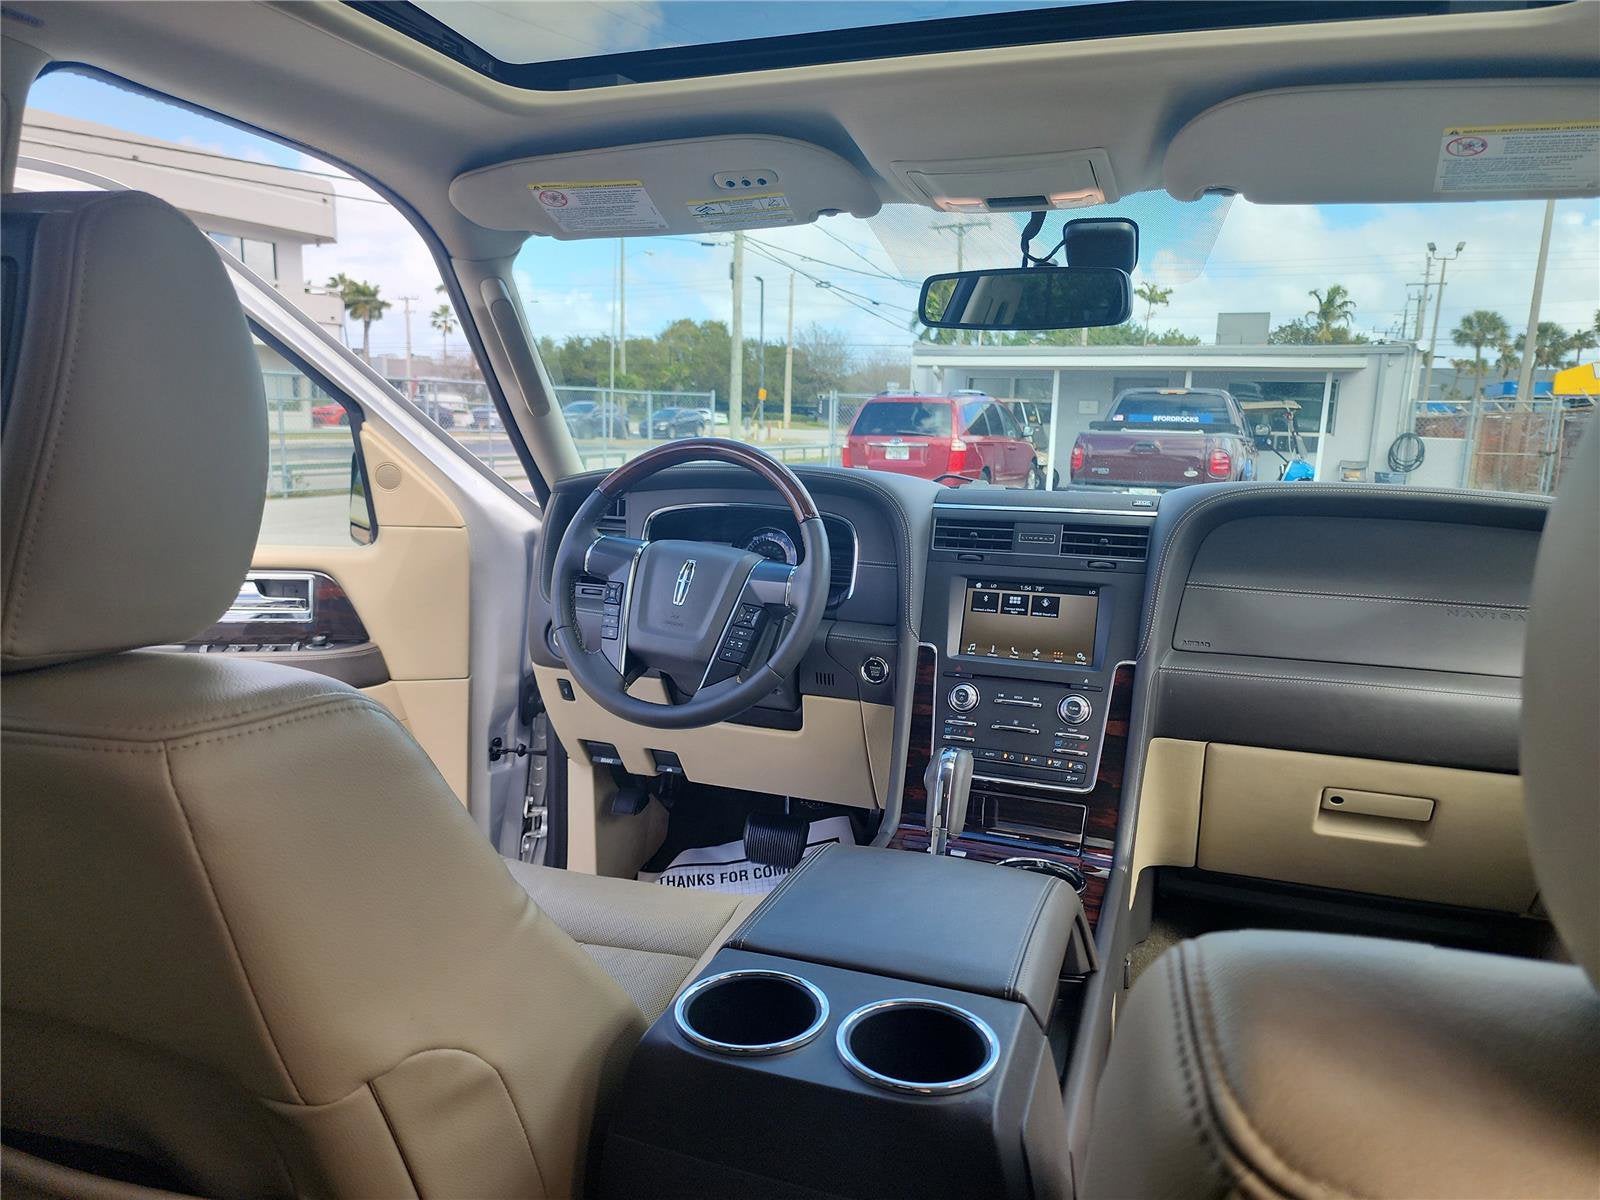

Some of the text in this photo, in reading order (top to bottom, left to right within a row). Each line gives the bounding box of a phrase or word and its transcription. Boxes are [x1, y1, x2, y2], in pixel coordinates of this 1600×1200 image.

[1152, 414, 1199, 423] #FORDROCKS
[659, 873, 715, 888] THANKS
[720, 869, 749, 884] FOR
